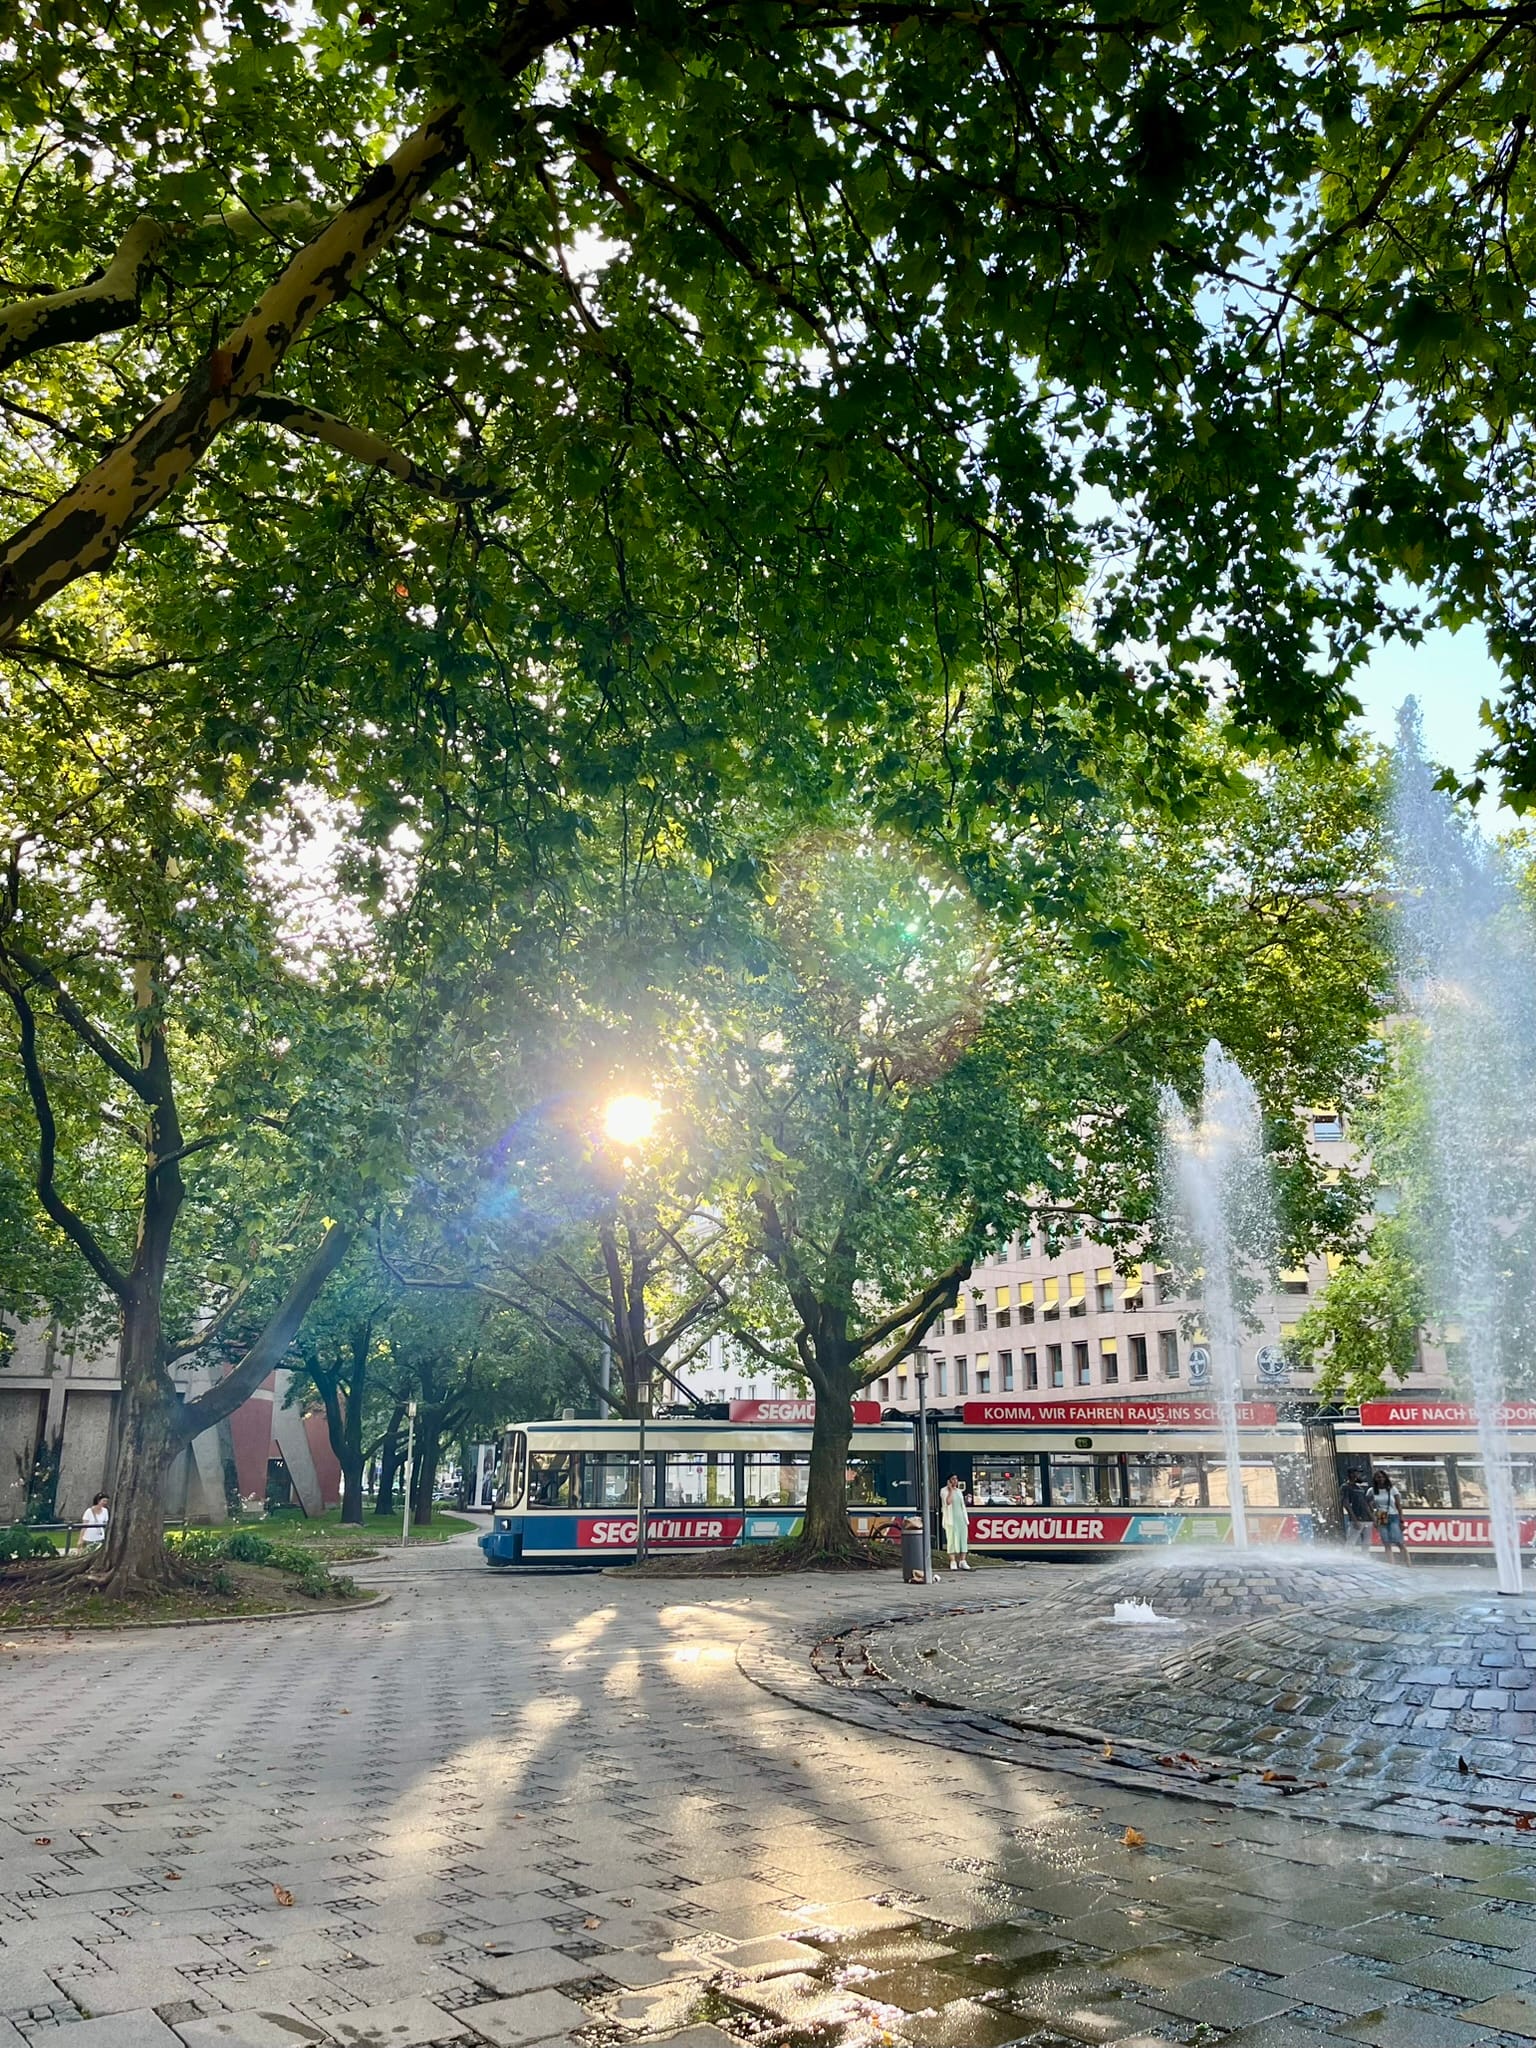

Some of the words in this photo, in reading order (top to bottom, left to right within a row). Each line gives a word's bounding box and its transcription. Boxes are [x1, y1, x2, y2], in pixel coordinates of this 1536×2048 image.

[984, 1407, 1035, 1421] KOMM,
[1039, 1407, 1066, 1420] WIR
[1070, 1407, 1124, 1420] FAHREN
[1128, 1407, 1165, 1420] RAUS
[1168, 1407, 1190, 1420] INS
[1389, 1407, 1419, 1421] AUF
[1422, 1407, 1462, 1421] NACH
[975, 1518, 1104, 1539] SEGMÜLLER
